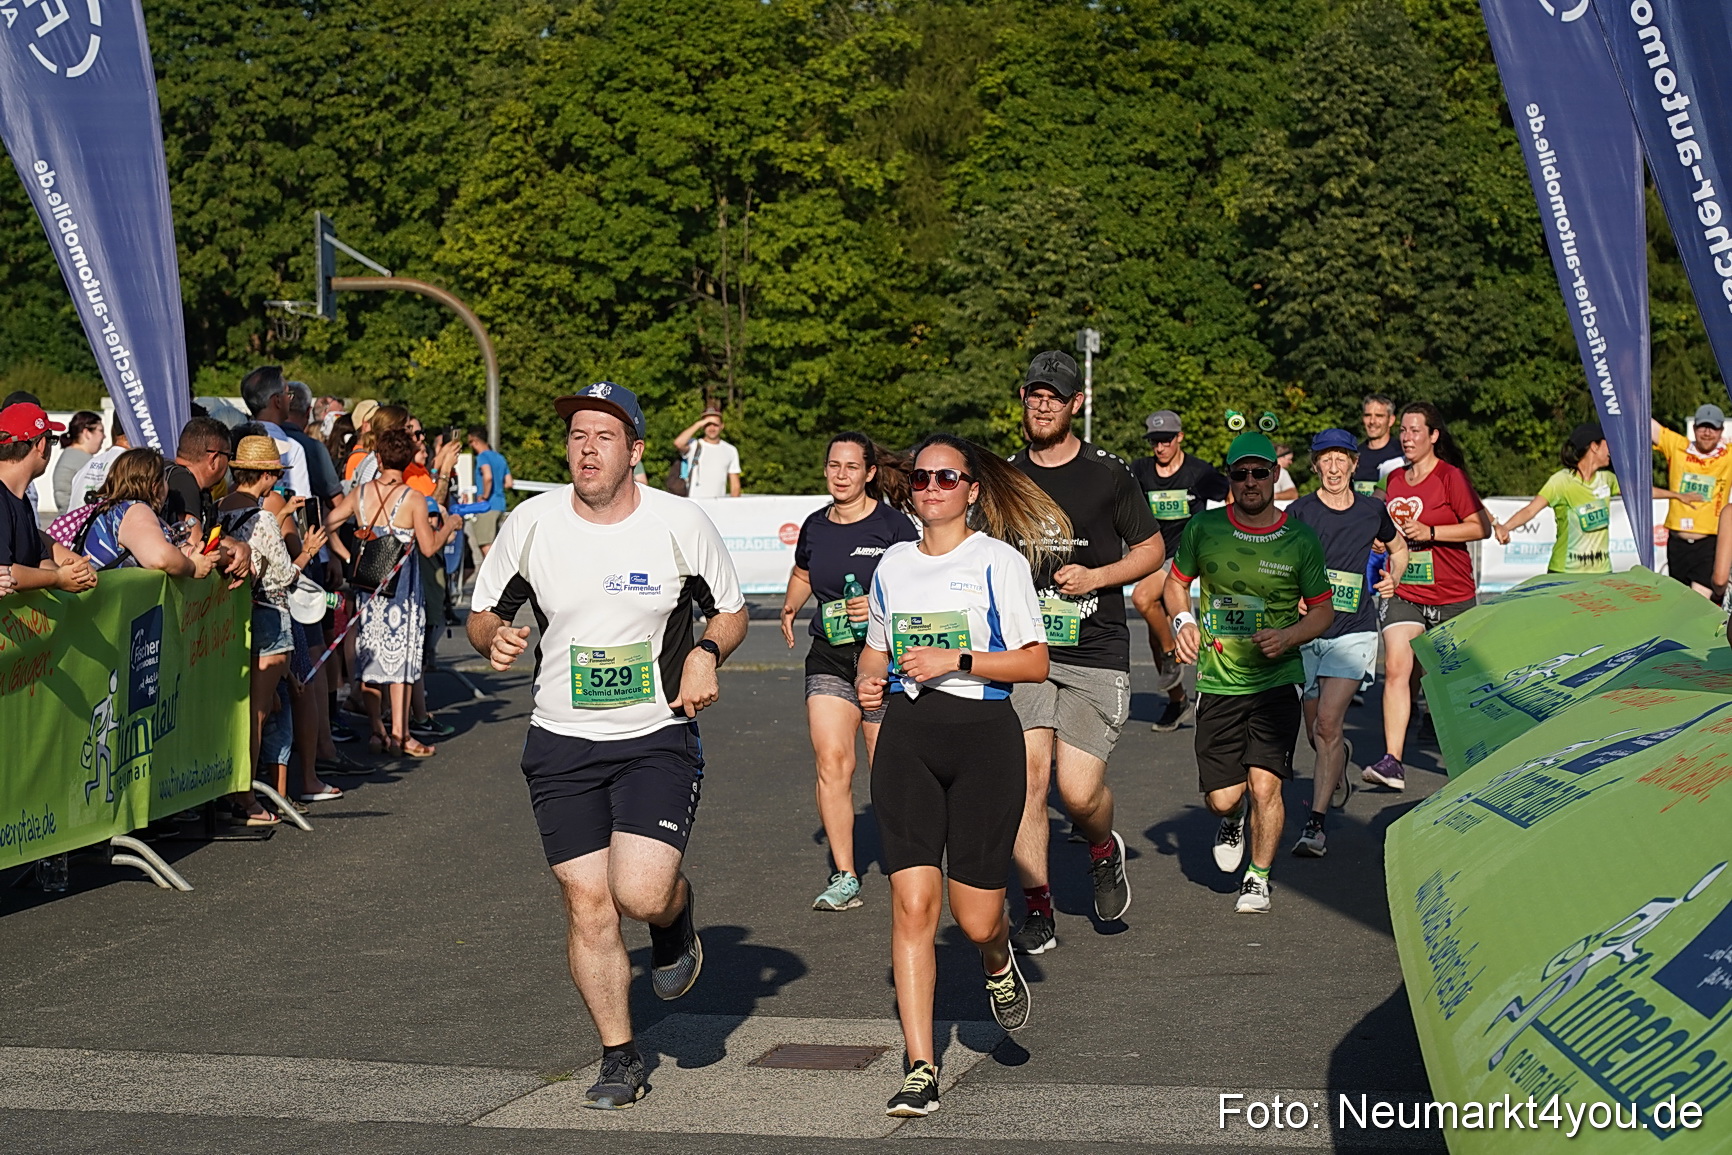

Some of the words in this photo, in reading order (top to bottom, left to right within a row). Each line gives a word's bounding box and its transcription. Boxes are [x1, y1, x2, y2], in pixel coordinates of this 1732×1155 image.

[1159, 501, 1179, 510] 859
[1588, 509, 1604, 521] 677
[624, 584, 661, 592] Firmenlauf
[834, 615, 851, 631] 72
[1225, 610, 1245, 625] 42
[575, 673, 583, 695] RUN
[590, 666, 632, 688] 529
[641, 666, 651, 694] 2022
[583, 688, 612, 697] Schmid
[614, 686, 642, 696] Marcus
